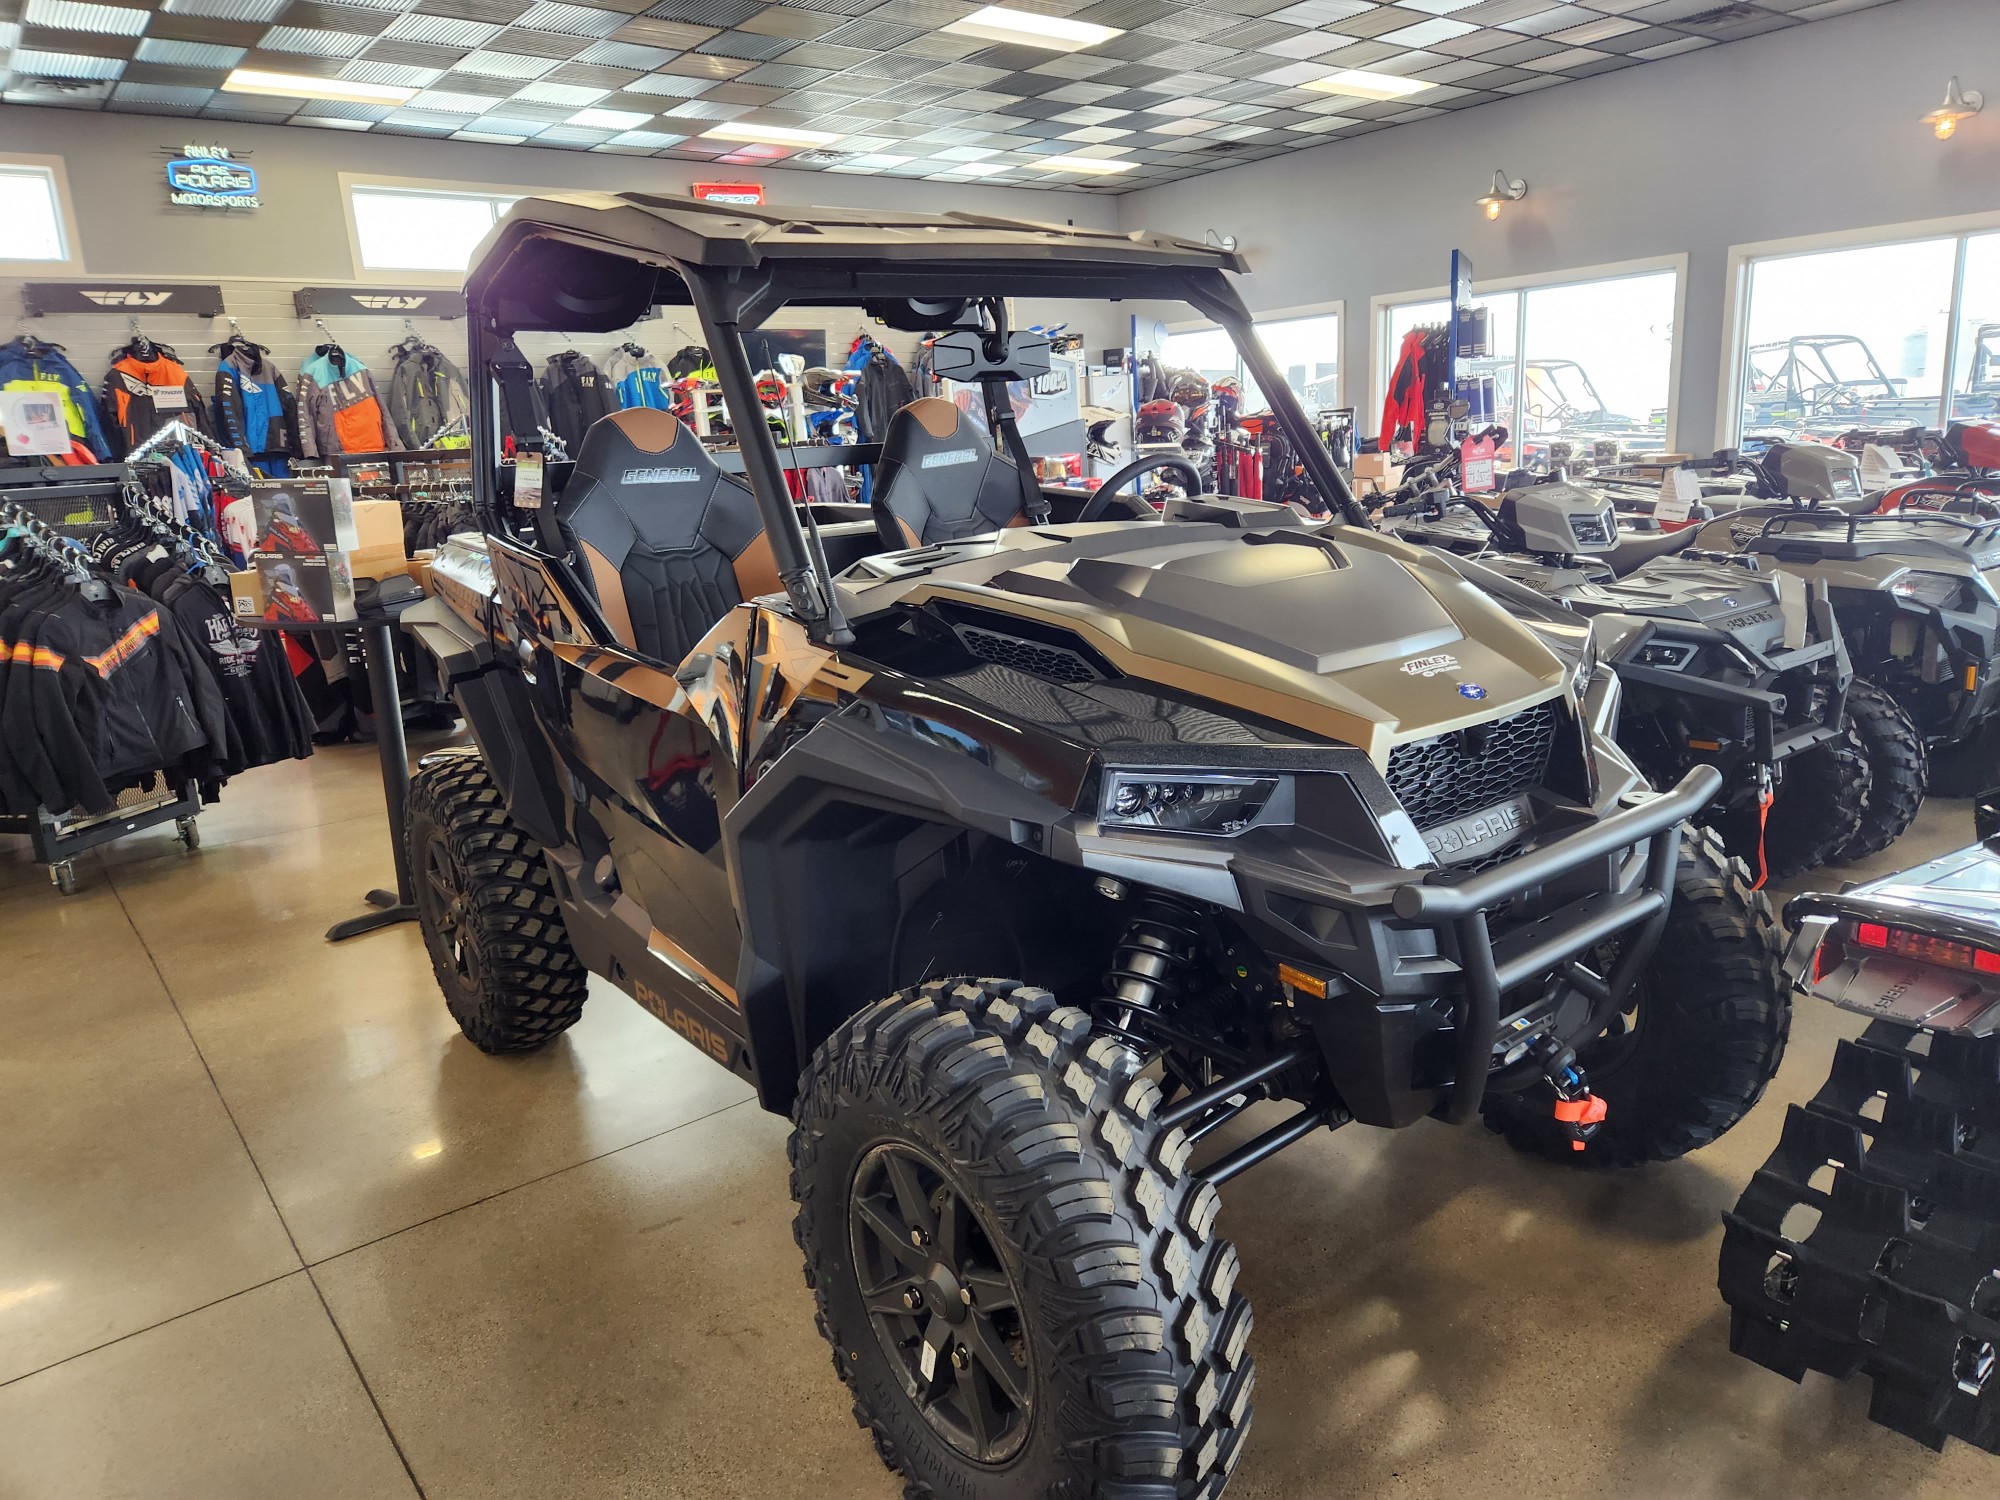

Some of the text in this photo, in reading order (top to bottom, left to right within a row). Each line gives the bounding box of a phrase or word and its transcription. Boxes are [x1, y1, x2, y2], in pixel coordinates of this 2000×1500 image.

[183, 145, 231, 159] FINLEY
[190, 164, 230, 176] PURE
[175, 174, 252, 189] POLARIS
[171, 193, 260, 208] MOTORSPORTS
[79, 290, 173, 306] FLY
[350, 295, 427, 309] FLY
[40, 372, 60, 381] FLY
[1035, 370, 1068, 394] 100%
[327, 371, 367, 406] FLY
[920, 448, 979, 469] GENERAL
[620, 467, 701, 485] GENERAL
[1406, 655, 1448, 672] FINLEY
[1426, 803, 1524, 856] POLARIS
[633, 980, 729, 1063] POLARIS
